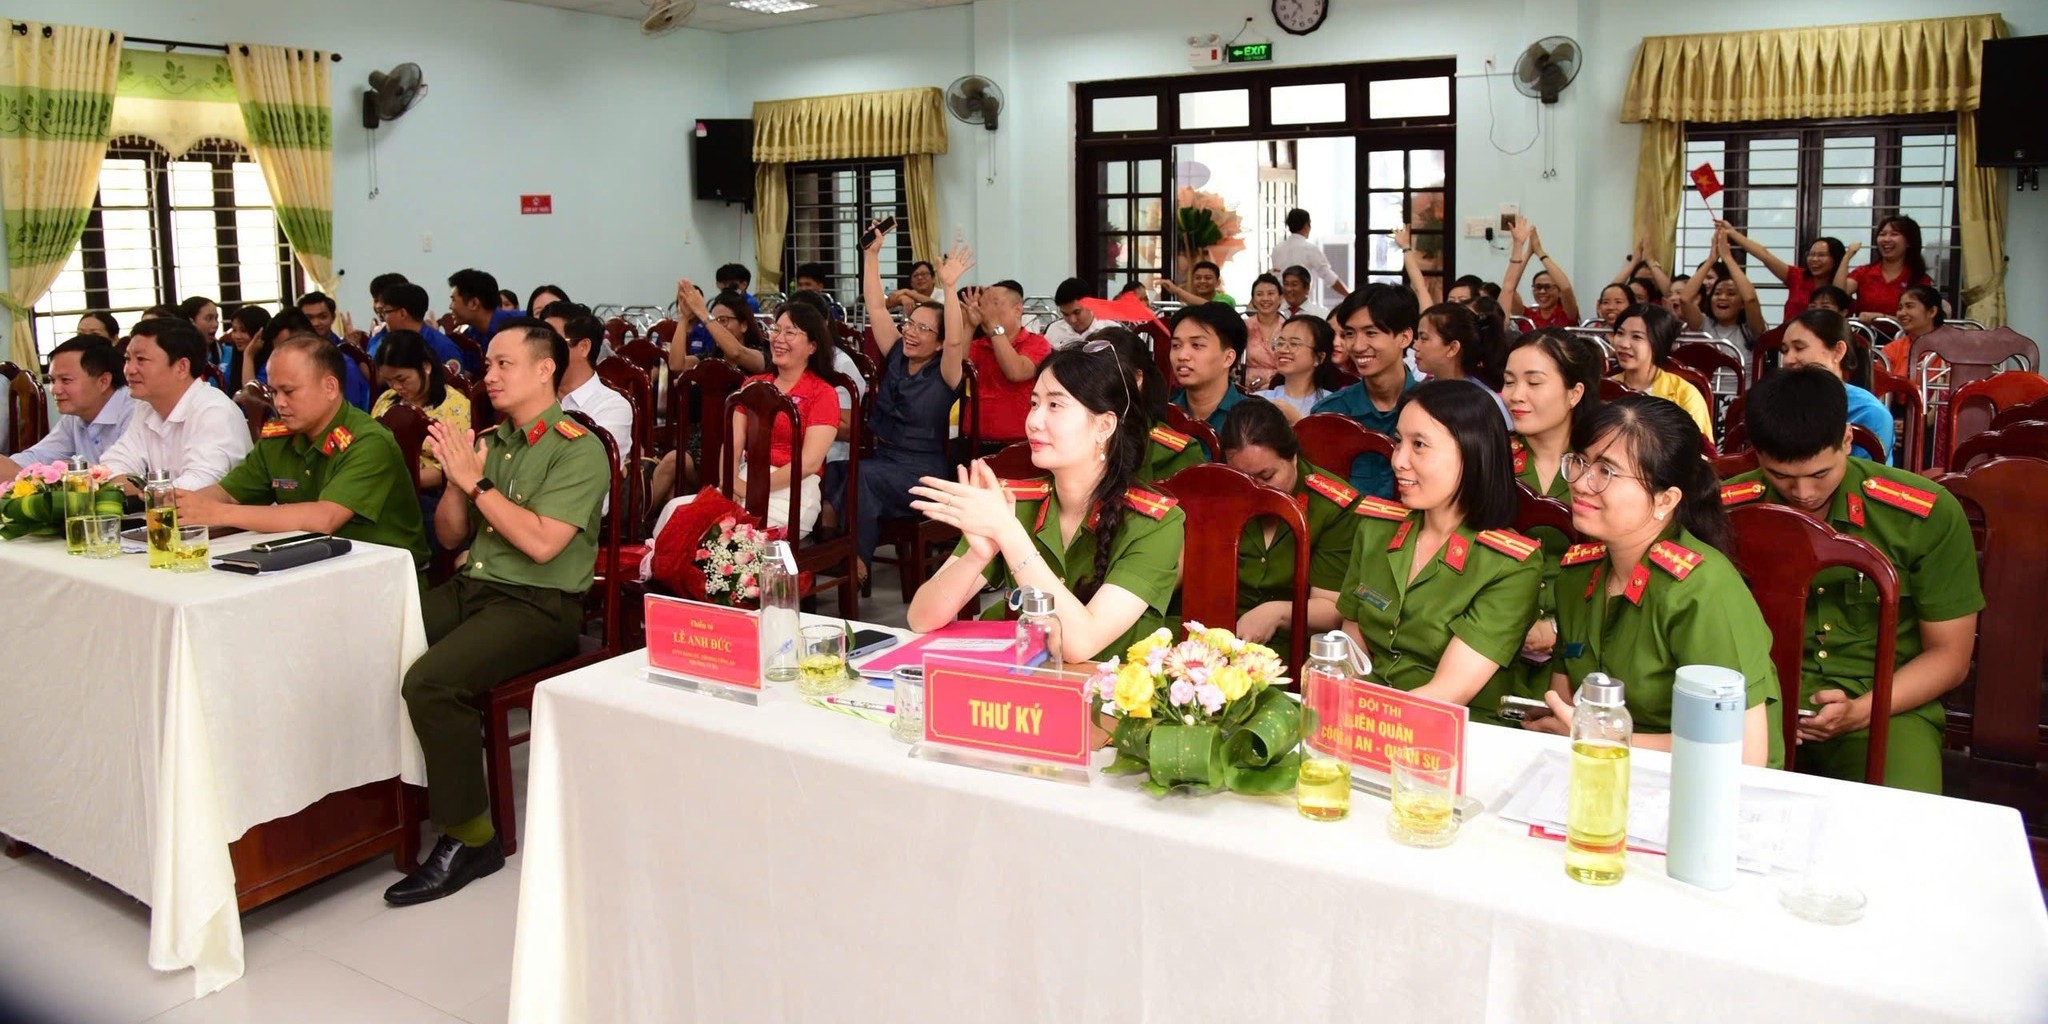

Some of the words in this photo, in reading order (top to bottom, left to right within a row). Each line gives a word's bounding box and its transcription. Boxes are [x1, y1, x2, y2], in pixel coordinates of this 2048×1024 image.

[1244, 45, 1267, 56] EXIT
[673, 630, 686, 644] LÊ
[688, 635, 708, 648] ANH
[711, 637, 731, 652] ĐỨC
[969, 699, 1011, 731] THƯ
[1015, 703, 1043, 736] KÝ
[1358, 697, 1379, 712] ĐỘI
[1382, 702, 1402, 718] THI
[1378, 720, 1414, 744] QUÂN
[1355, 735, 1372, 752] AN
